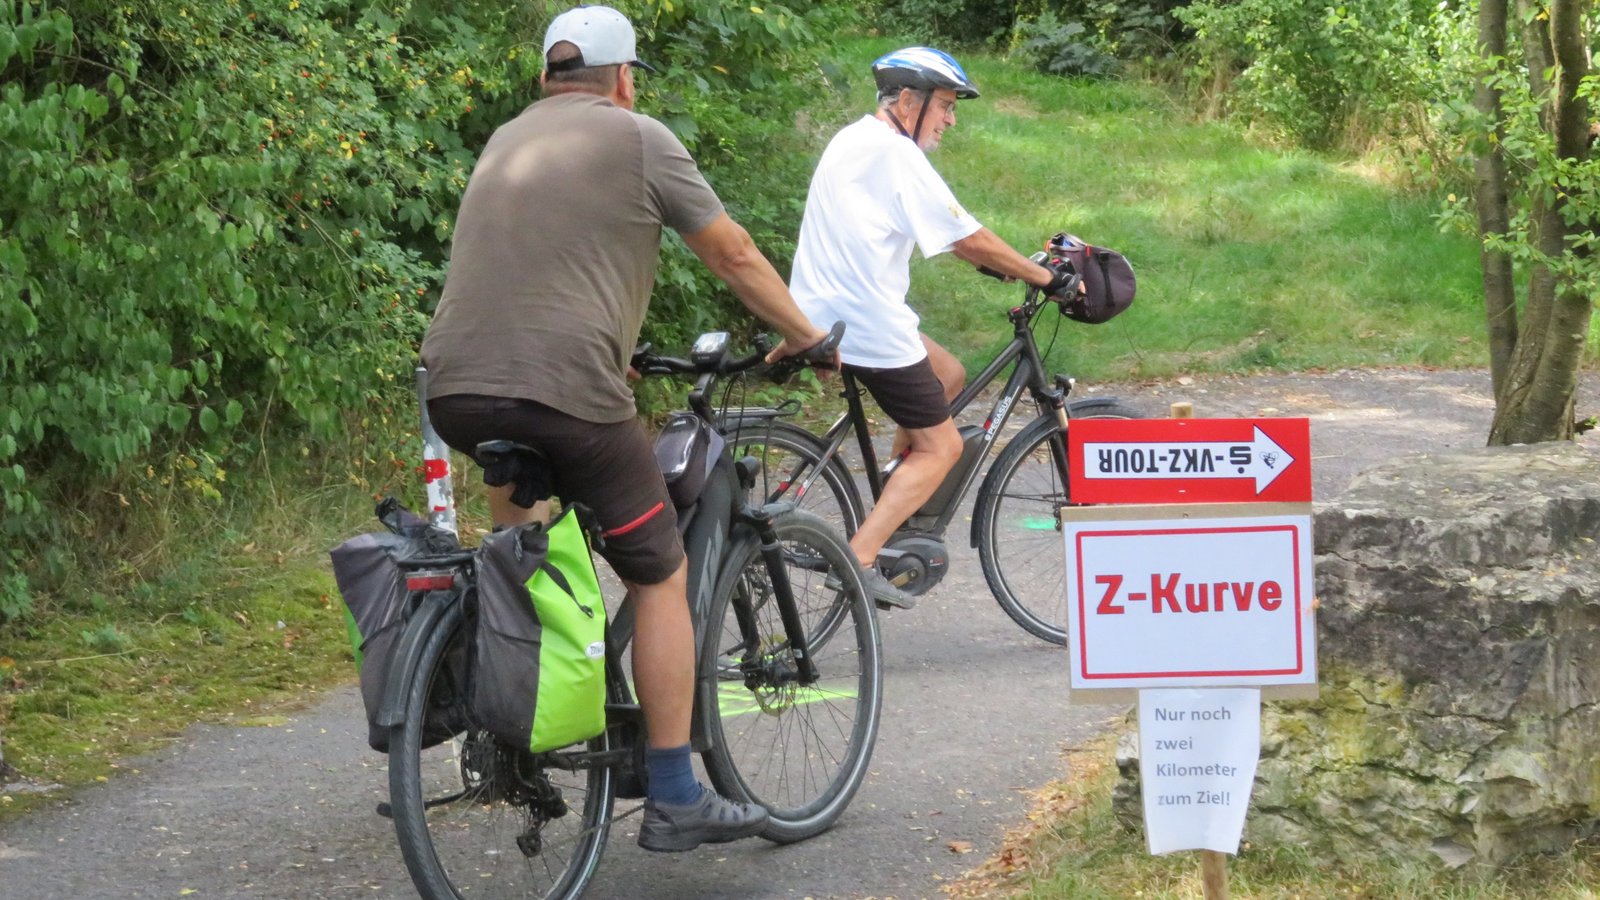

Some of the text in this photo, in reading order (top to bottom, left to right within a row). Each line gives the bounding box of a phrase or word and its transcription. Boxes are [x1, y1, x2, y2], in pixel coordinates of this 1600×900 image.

[988, 396, 1012, 435] PEGASUS
[1095, 573, 1282, 615] Z-Kurve
[1155, 706, 1231, 721] Nur noch
[1155, 736, 1193, 750] zwei
[1156, 763, 1237, 777] Kilometer
[1157, 791, 1230, 806] zum Ziel!
